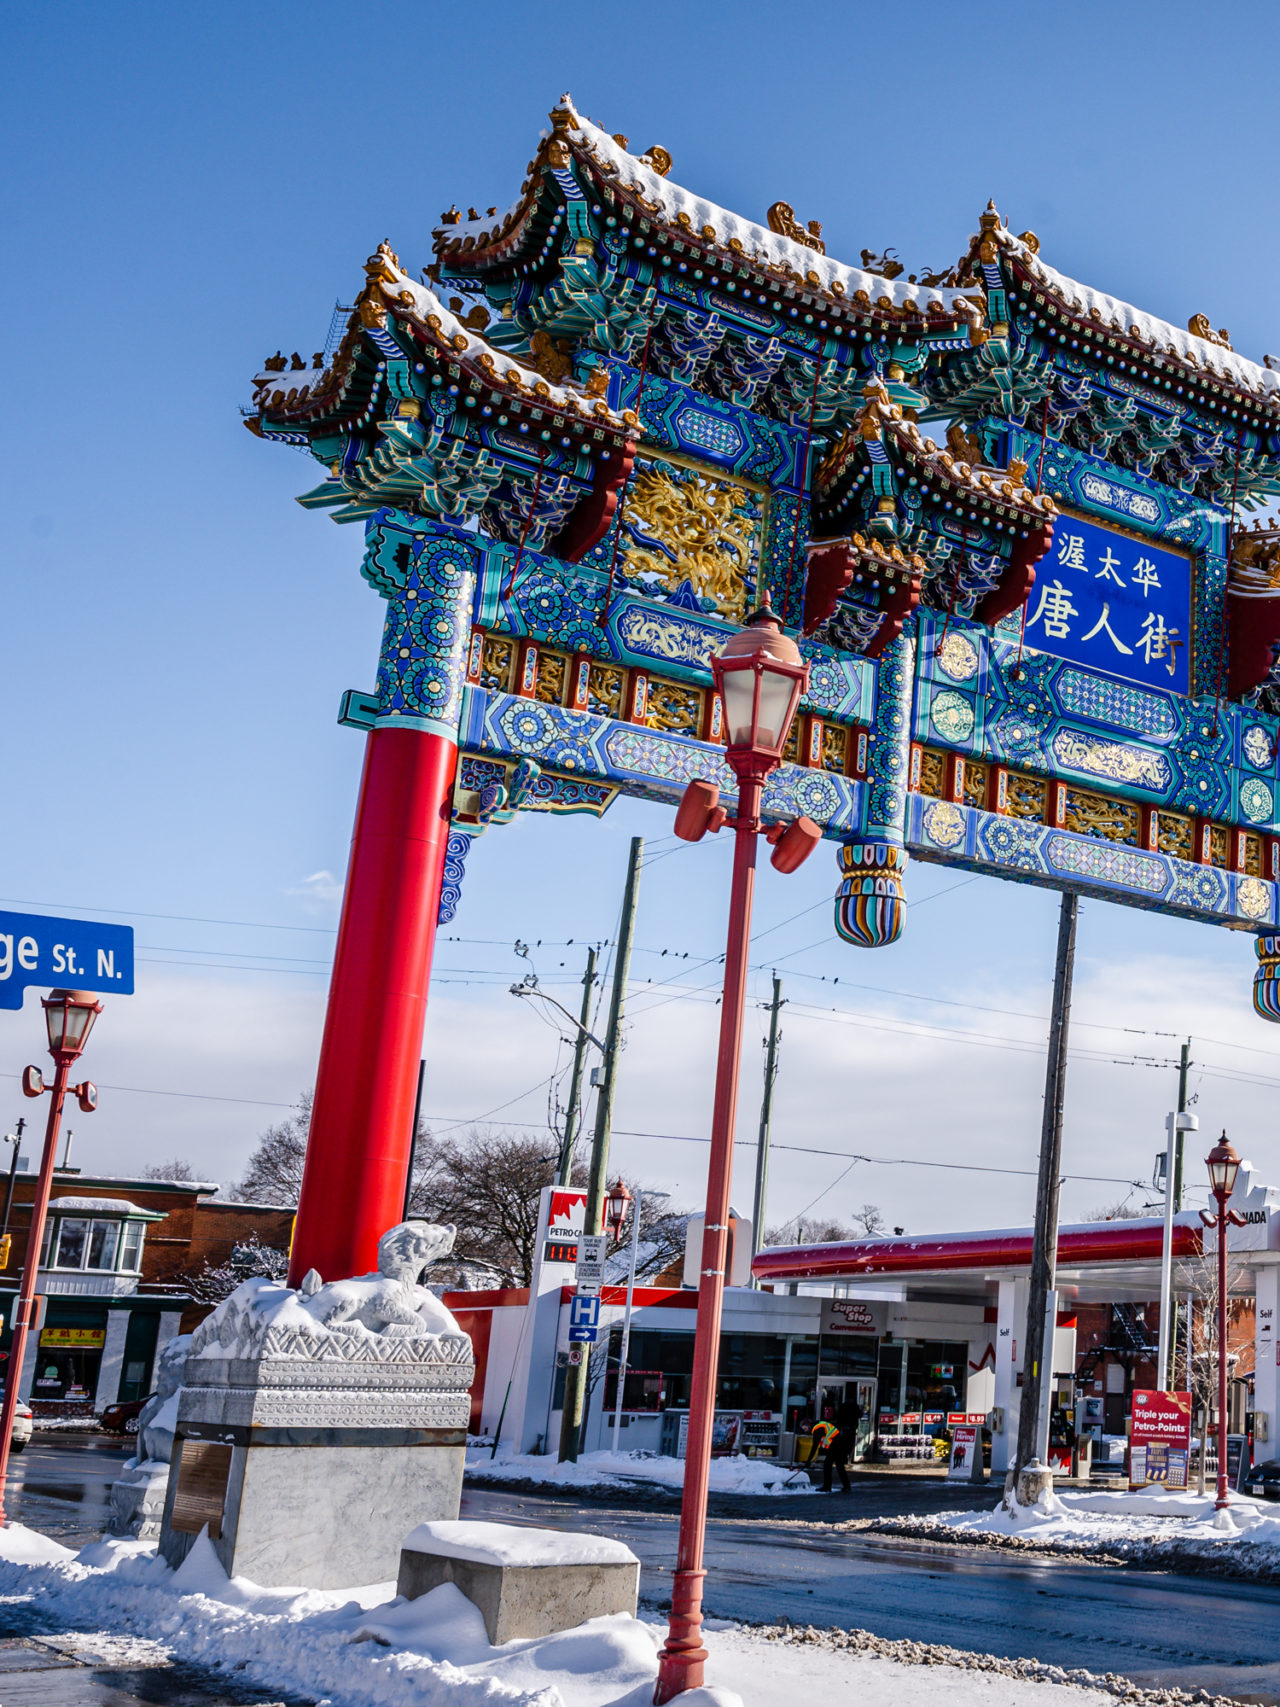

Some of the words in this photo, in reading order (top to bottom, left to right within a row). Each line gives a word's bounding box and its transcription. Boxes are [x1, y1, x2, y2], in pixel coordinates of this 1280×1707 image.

[1057, 532, 1162, 598] 渥太华
[1025, 579, 1184, 676] 唐人街
[52, 943, 85, 975] St.
[97, 948, 122, 979] N.
[574, 1298, 597, 1324] H
[832, 1302, 866, 1314] Super
[1260, 1309, 1273, 1318] Self
[847, 1311, 872, 1324] Stop
[1134, 1409, 1157, 1419] Triple
[1158, 1412, 1179, 1420] your
[1134, 1421, 1186, 1433] Petro-Points
